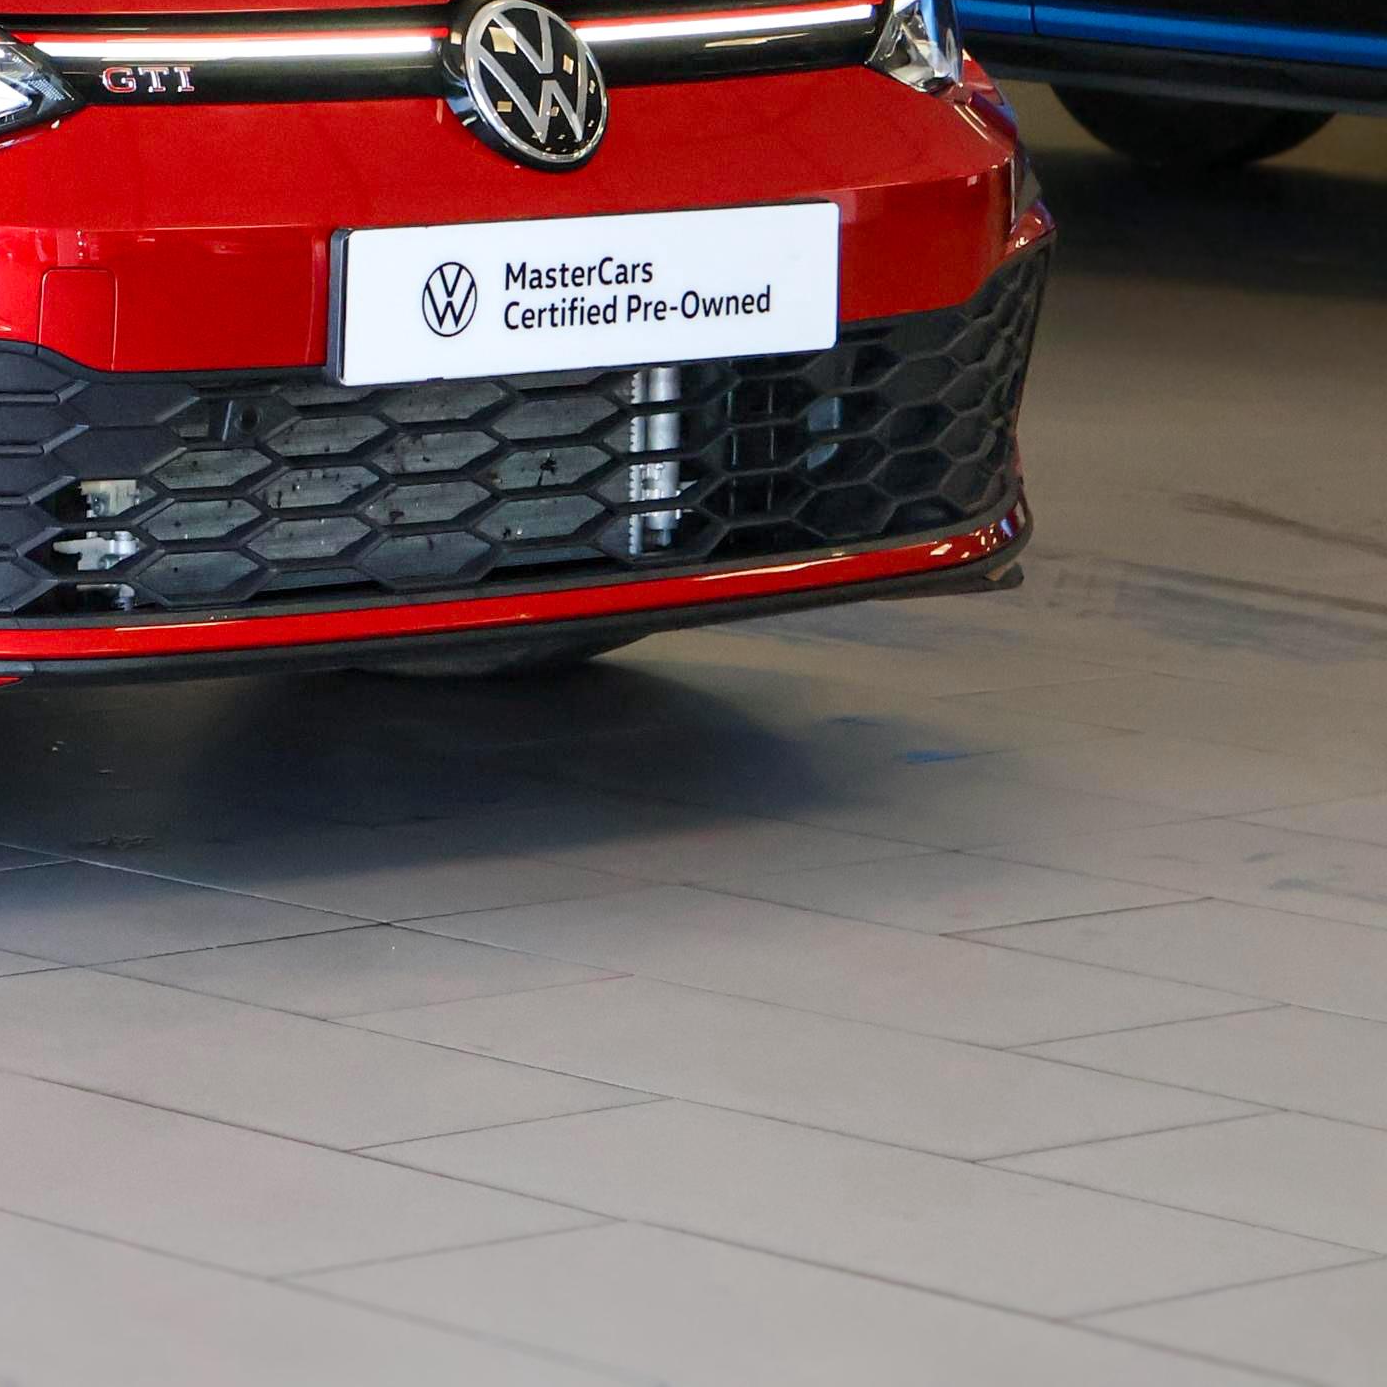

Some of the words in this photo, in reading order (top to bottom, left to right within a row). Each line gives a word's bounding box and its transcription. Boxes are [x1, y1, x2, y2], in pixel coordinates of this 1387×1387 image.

[102, 66, 195, 93] GTI
[504, 256, 654, 291] MasterCars
[503, 295, 618, 330] Certified
[626, 284, 772, 323] Pre-Owned
